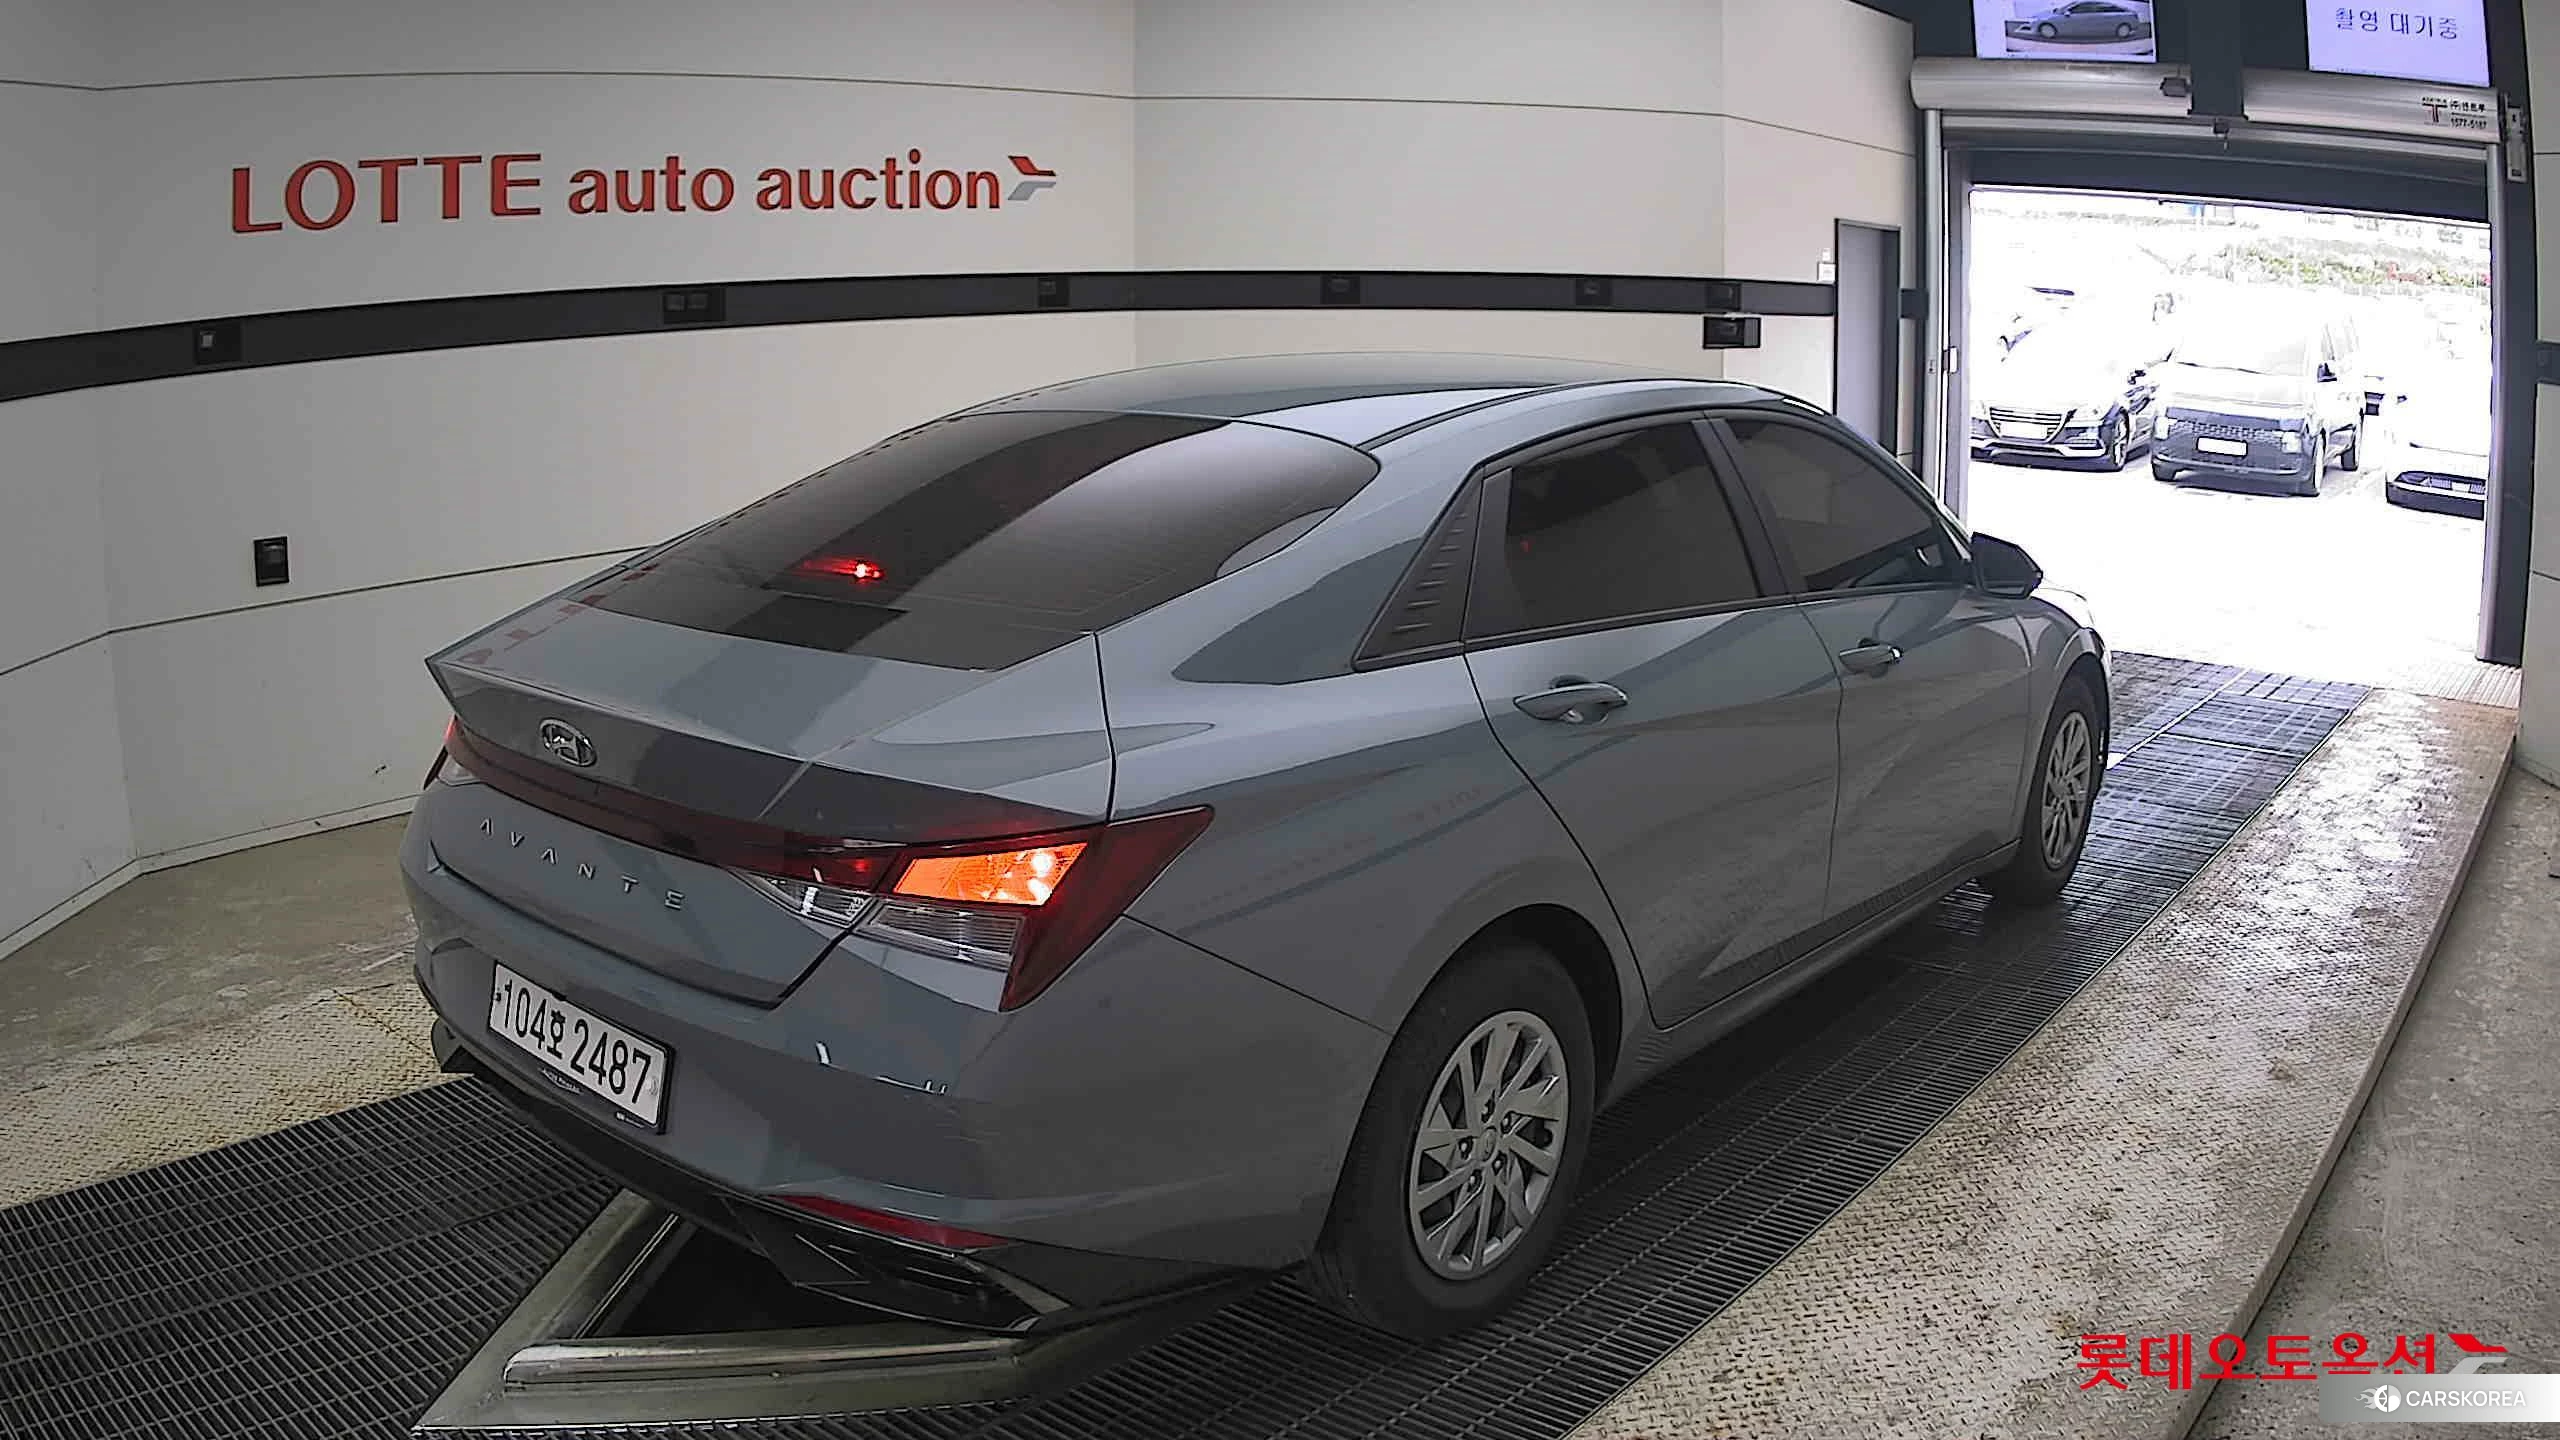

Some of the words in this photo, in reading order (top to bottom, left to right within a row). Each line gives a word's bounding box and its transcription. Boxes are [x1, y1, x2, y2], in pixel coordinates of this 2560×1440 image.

[2336, 8, 2378, 32] 촬영
[2390, 12, 2457, 40] 대기중
[232, 153, 542, 233] LOTTE
[568, 155, 736, 215] auto
[756, 148, 1001, 212] auction
[479, 817, 685, 911] AVANTE
[504, 979, 566, 1060] 104호
[570, 1018, 651, 1105] 2487
